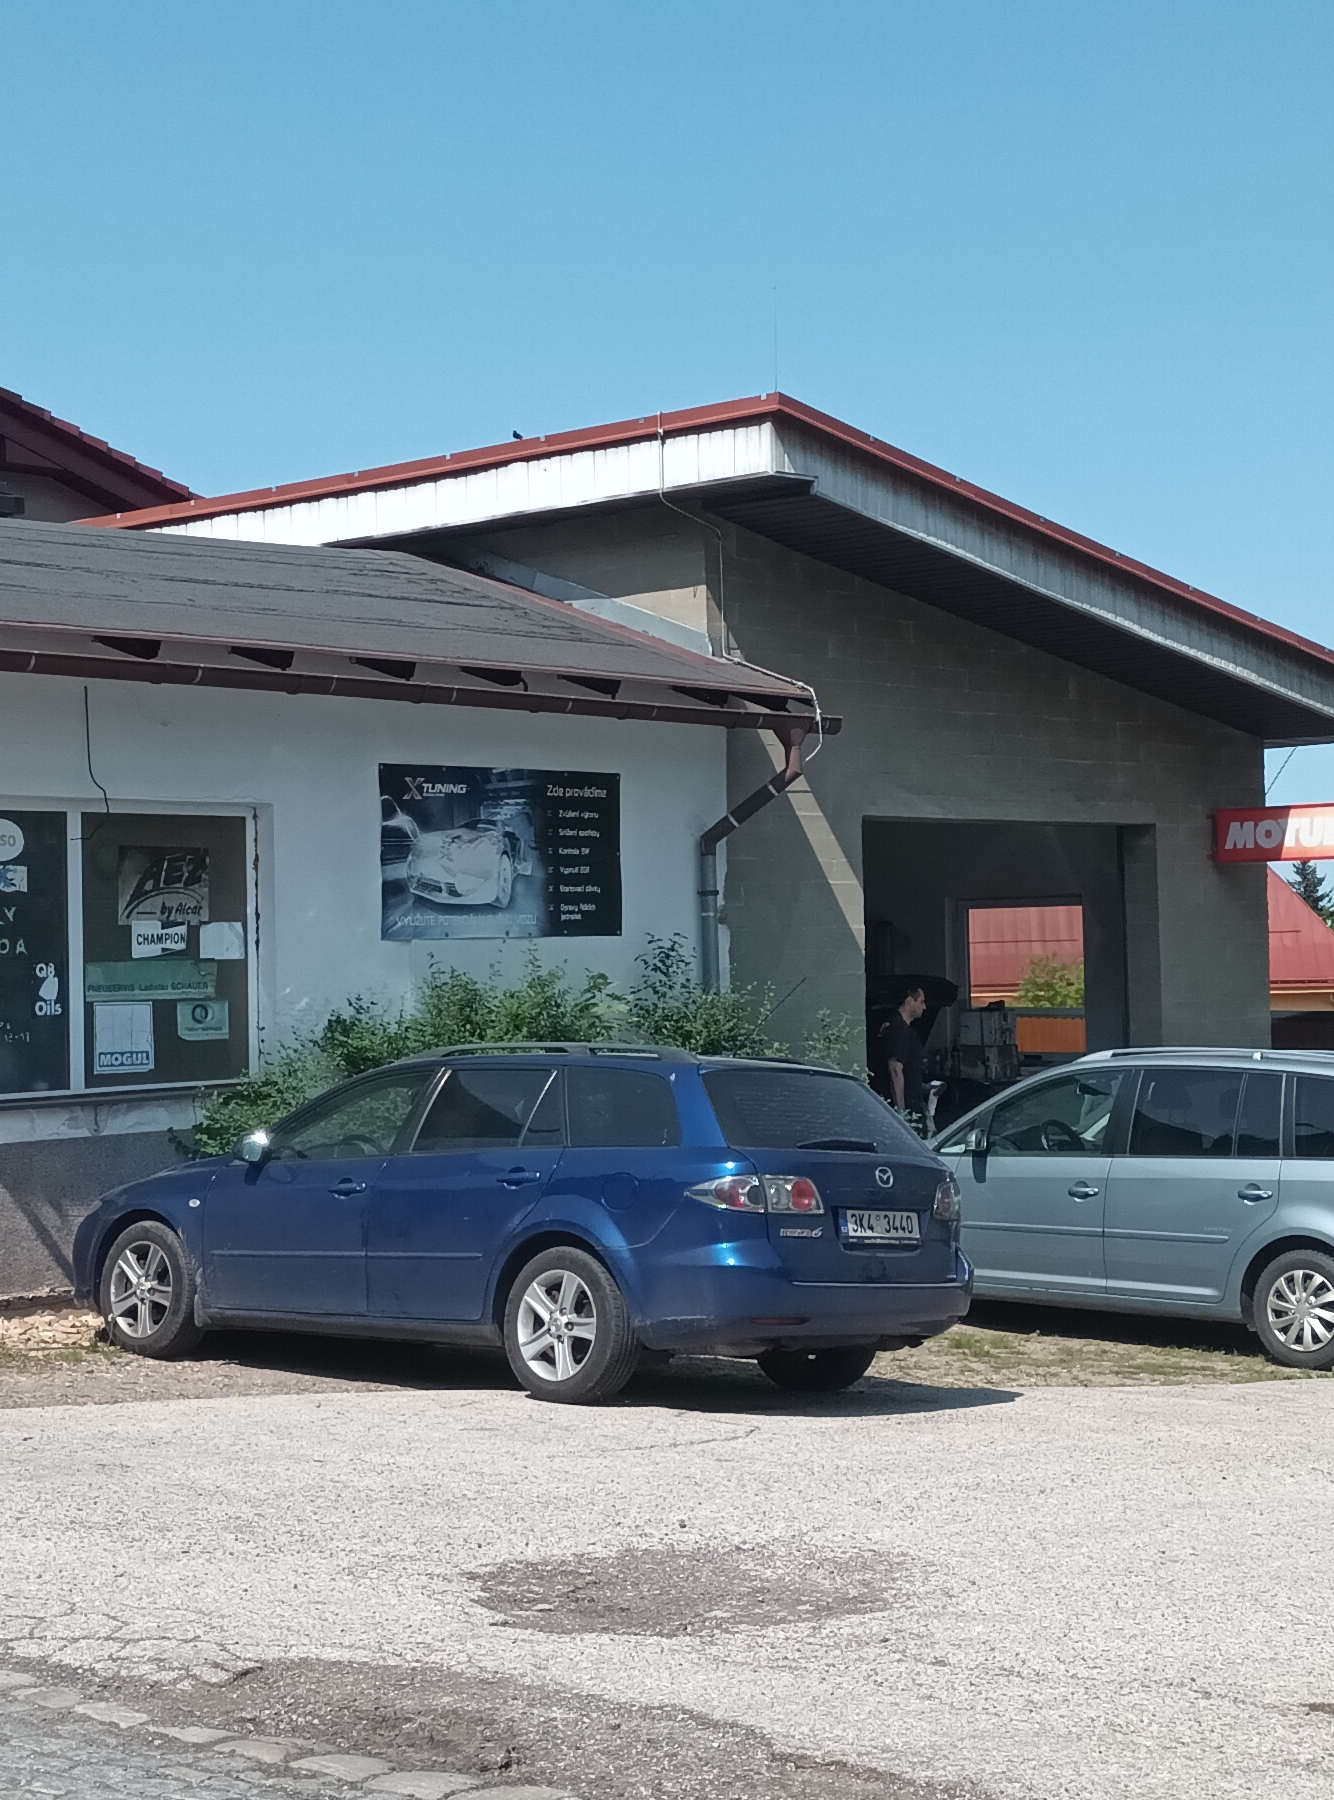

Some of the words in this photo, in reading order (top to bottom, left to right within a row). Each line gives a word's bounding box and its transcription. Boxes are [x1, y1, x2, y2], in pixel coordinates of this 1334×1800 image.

[547, 785, 564, 796] Zde
[161, 902, 174, 920] by
[175, 902, 204, 916] Alcar
[136, 933, 186, 946] CHAMPION
[35, 1002, 62, 1016] Oils
[99, 1053, 150, 1066] MOGUL
[850, 1213, 874, 1233] 3K4
[884, 1214, 913, 1234] 3440
